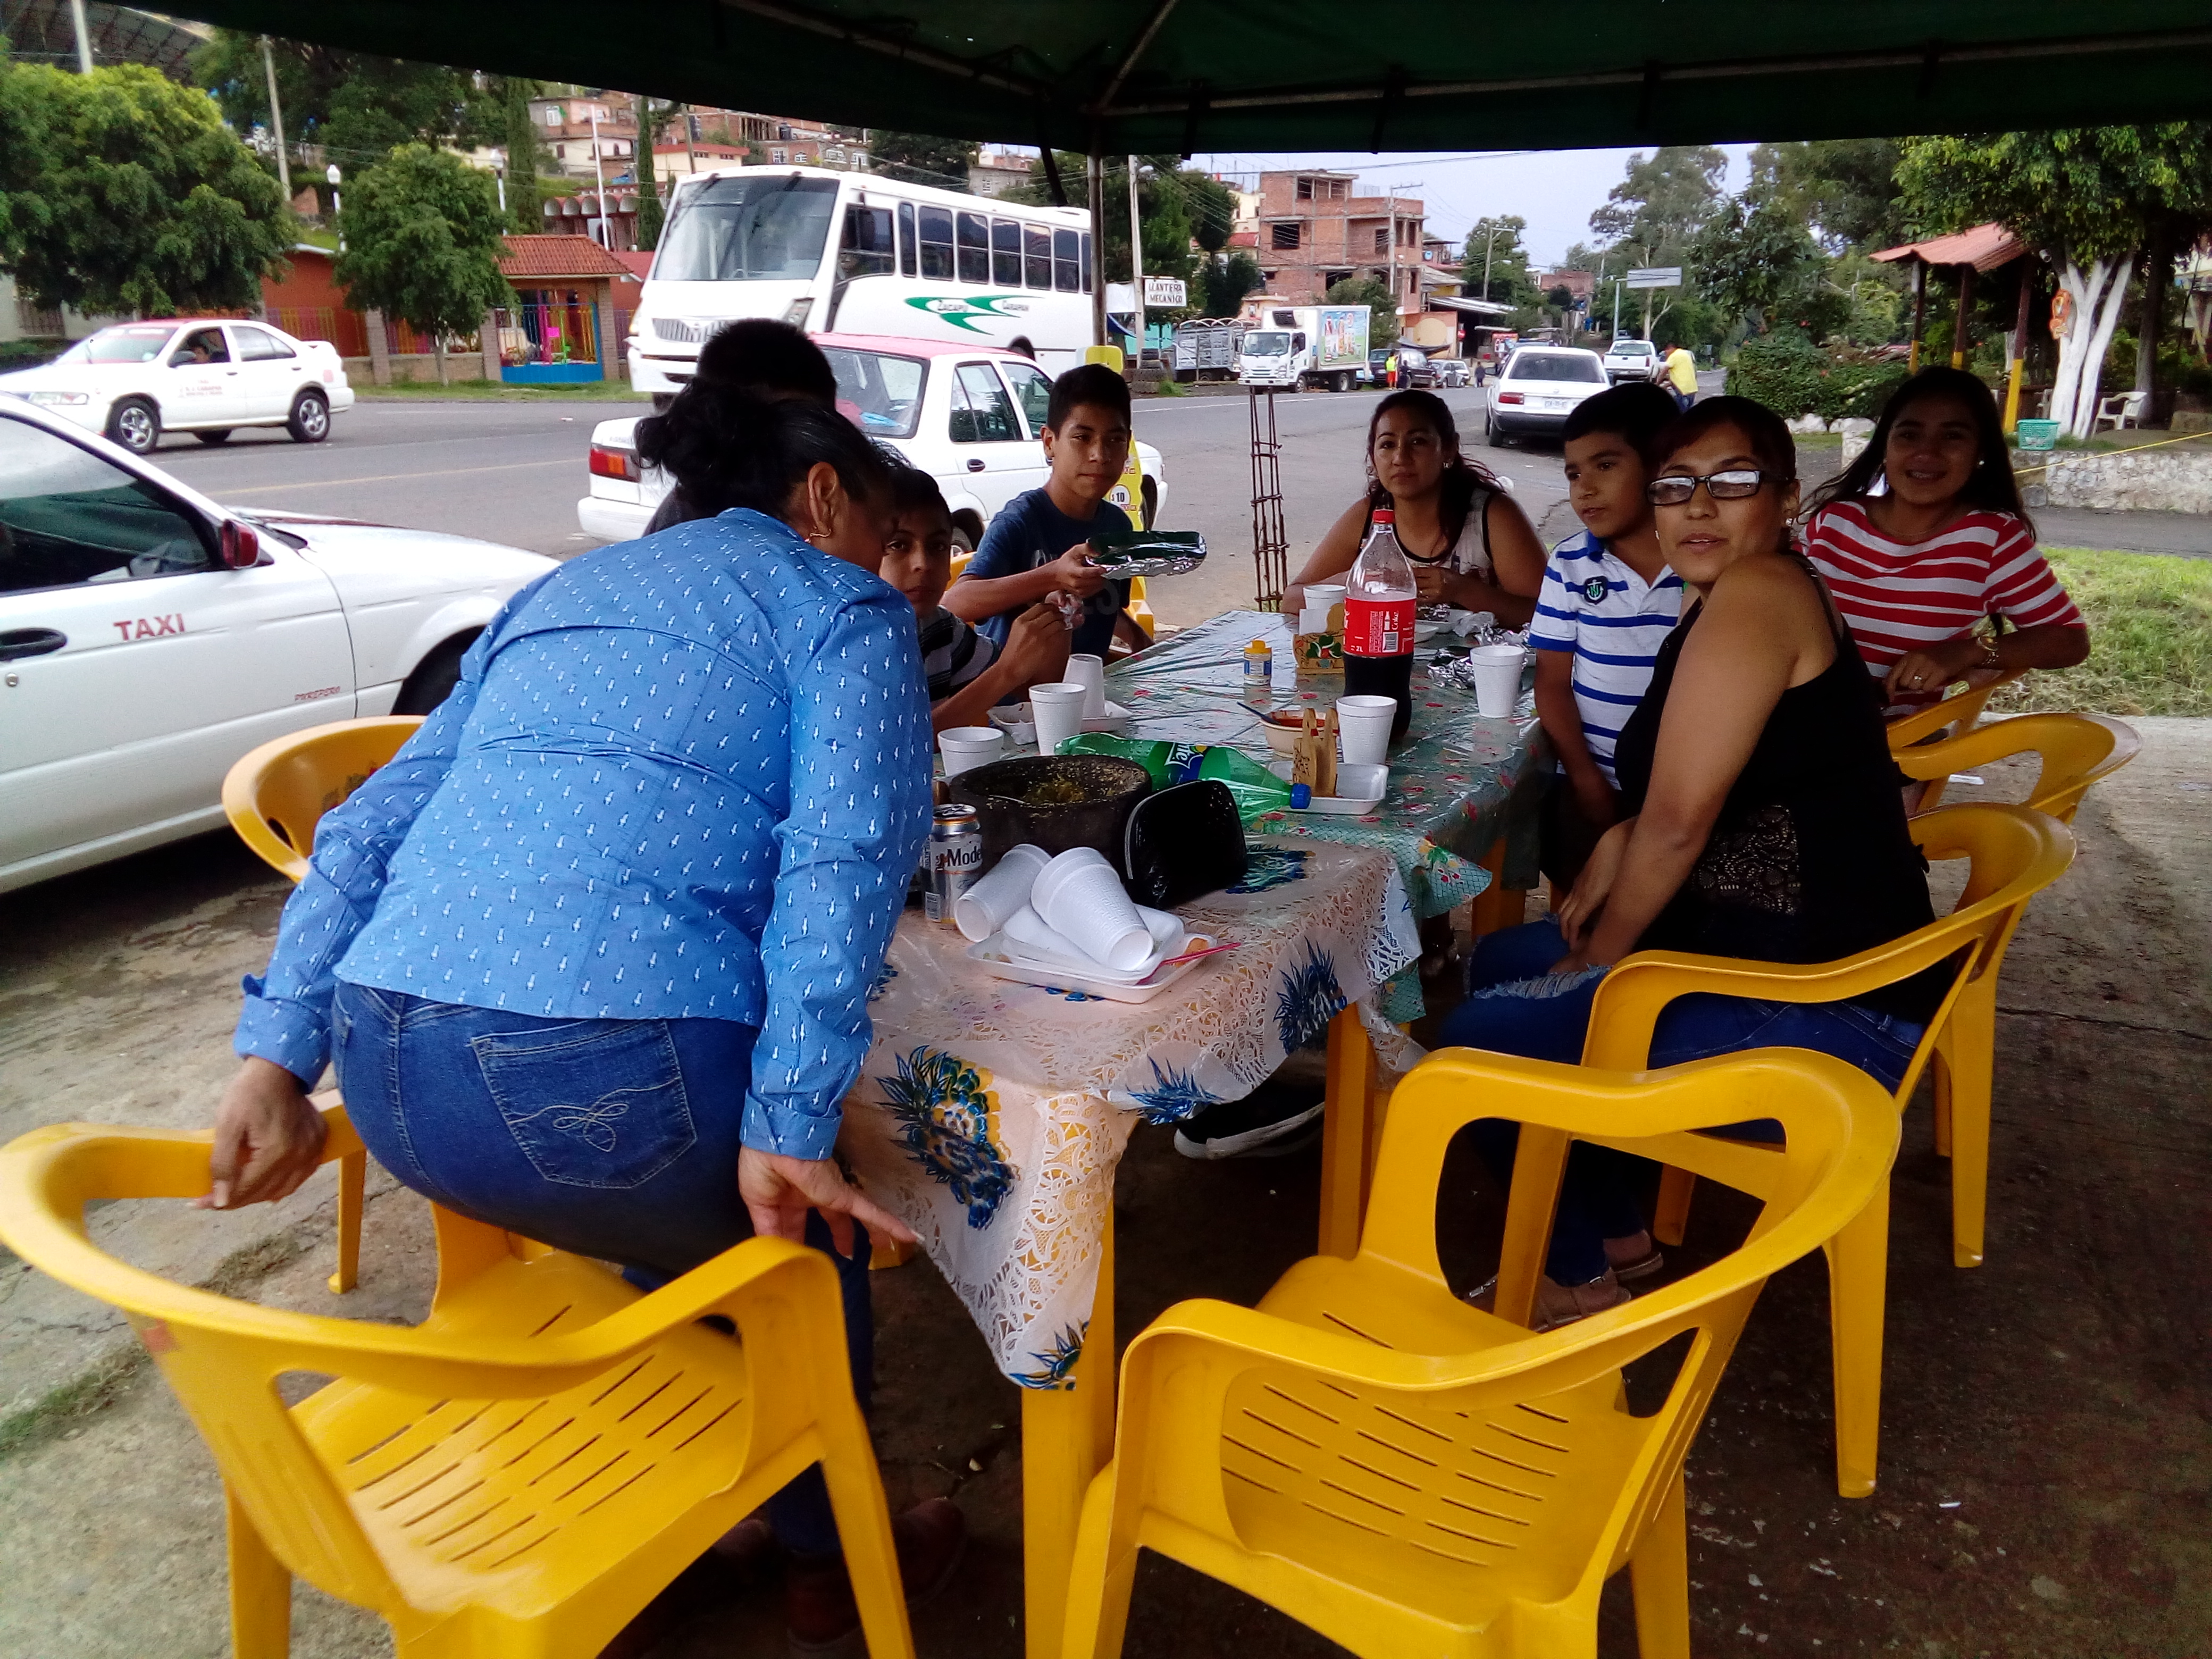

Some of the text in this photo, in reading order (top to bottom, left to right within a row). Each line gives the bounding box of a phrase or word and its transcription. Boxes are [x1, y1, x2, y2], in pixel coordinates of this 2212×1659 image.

[1149, 282, 1183, 292] LLANTERA
[1150, 294, 1183, 303] MECANICO
[113, 613, 185, 641] TAXI
[947, 846, 982, 867] Mode
